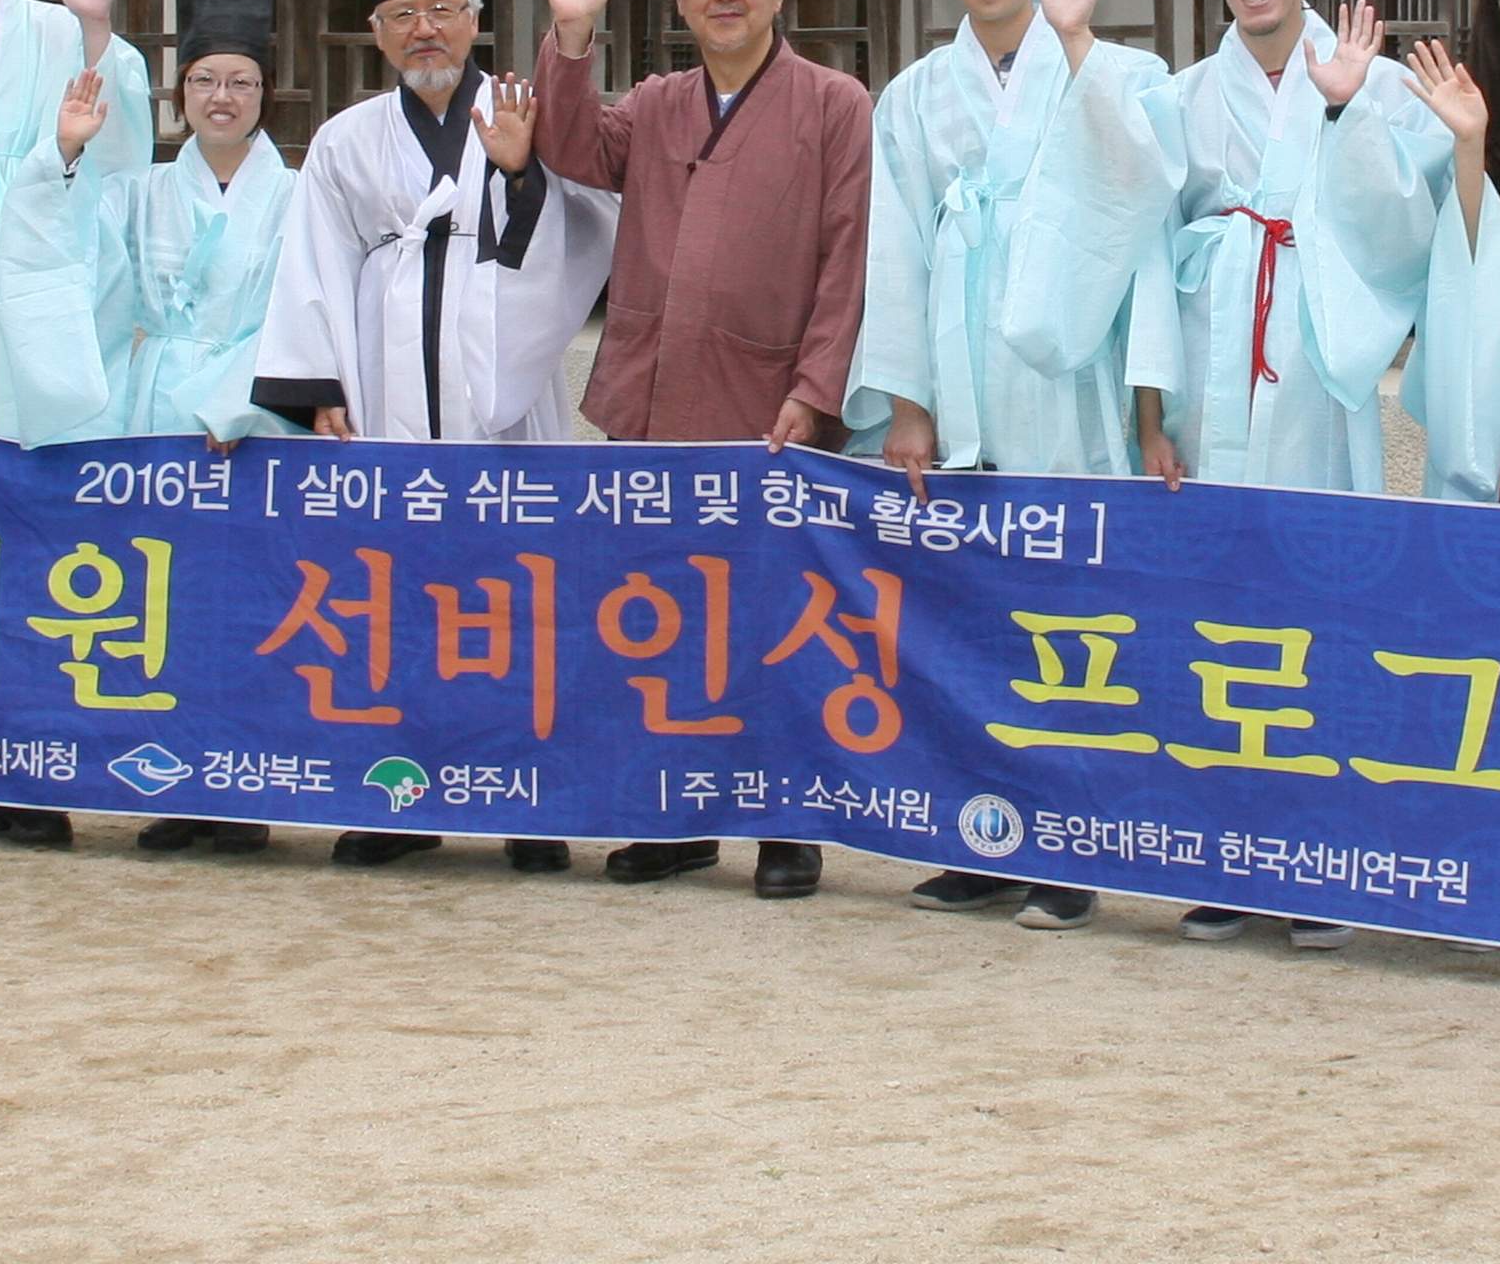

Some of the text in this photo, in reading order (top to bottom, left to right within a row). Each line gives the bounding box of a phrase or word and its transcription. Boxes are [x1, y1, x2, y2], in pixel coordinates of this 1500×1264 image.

[76, 459, 231, 511] 2016년
[297, 464, 388, 520] 살아
[402, 468, 449, 522] 숨
[465, 469, 559, 524] 쉬는
[575, 470, 672, 525] 서원
[694, 471, 739, 526] 및
[760, 470, 855, 530] 향교
[868, 490, 1066, 560] 활용사업
[255, 548, 902, 754] 선비인성
[202, 750, 335, 794] 경상북도
[439, 764, 538, 807] 영주시
[802, 775, 938, 836] 소수서원,
[1032, 810, 1206, 866] 동양대학교
[1219, 831, 1469, 905] 한국선비연구원
